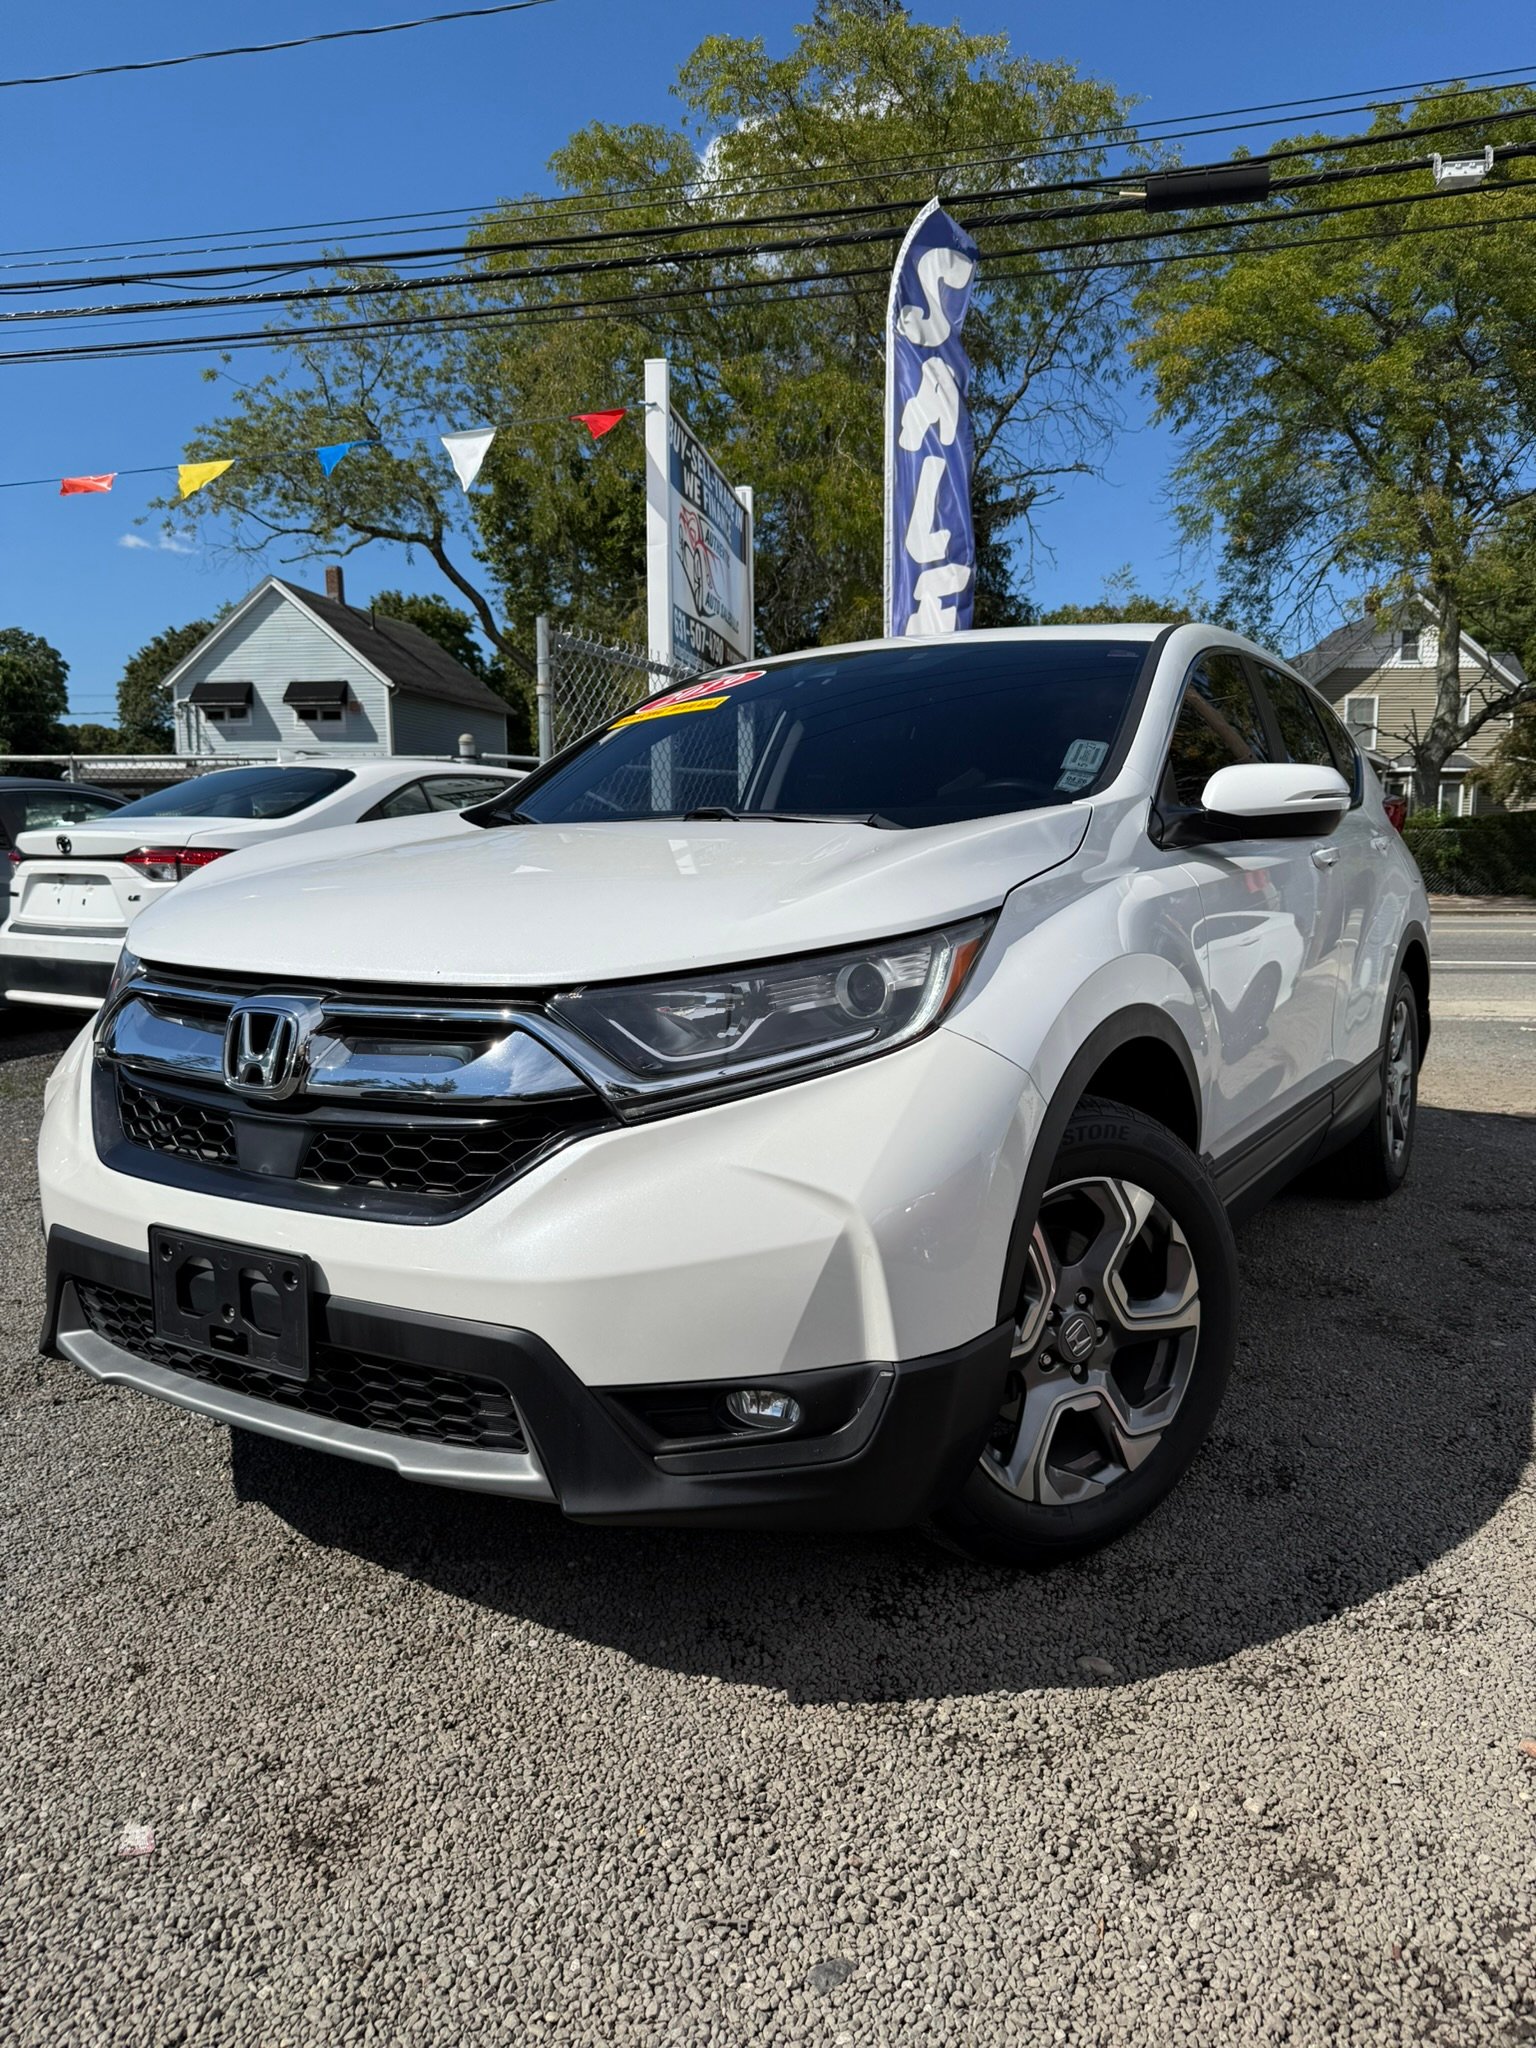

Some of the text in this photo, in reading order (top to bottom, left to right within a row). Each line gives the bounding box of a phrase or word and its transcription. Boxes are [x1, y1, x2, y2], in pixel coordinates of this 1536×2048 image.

[898, 247, 973, 636] SALE
[683, 465, 732, 545] WE FINANCE
[705, 591, 720, 614] AUTO
[1062, 1122, 1130, 1146] STONE
